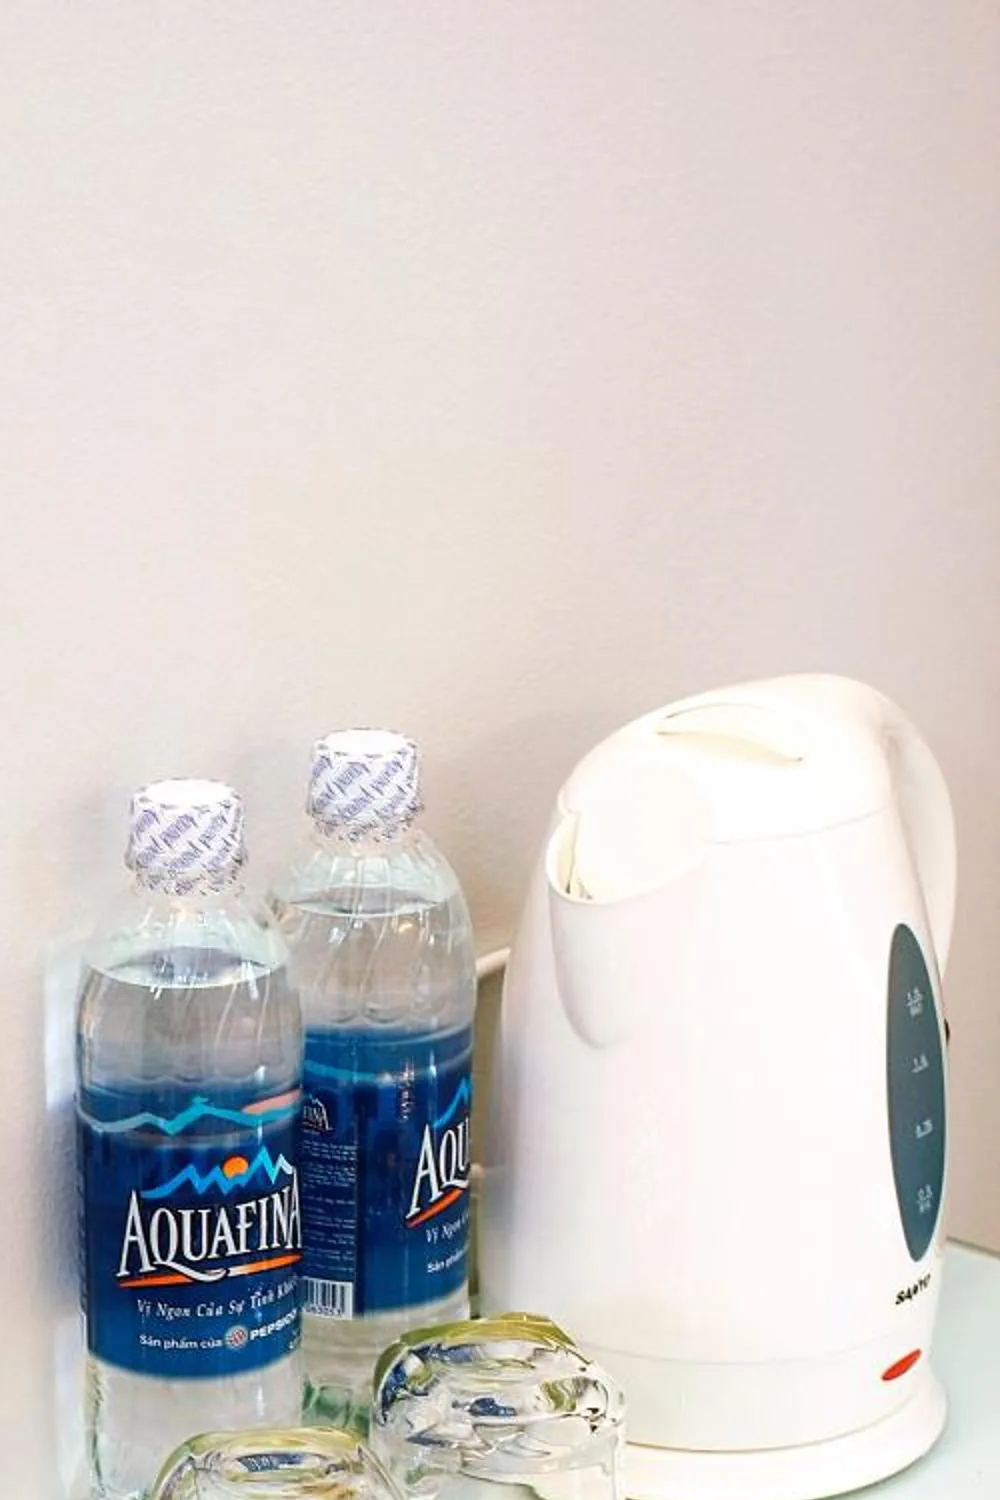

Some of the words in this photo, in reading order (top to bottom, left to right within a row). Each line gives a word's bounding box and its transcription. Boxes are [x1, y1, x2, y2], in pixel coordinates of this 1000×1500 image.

[405, 1116, 469, 1219] AQU
[116, 1167, 302, 1282] AQUAFINA
[156, 1301, 191, 1320] Ngon
